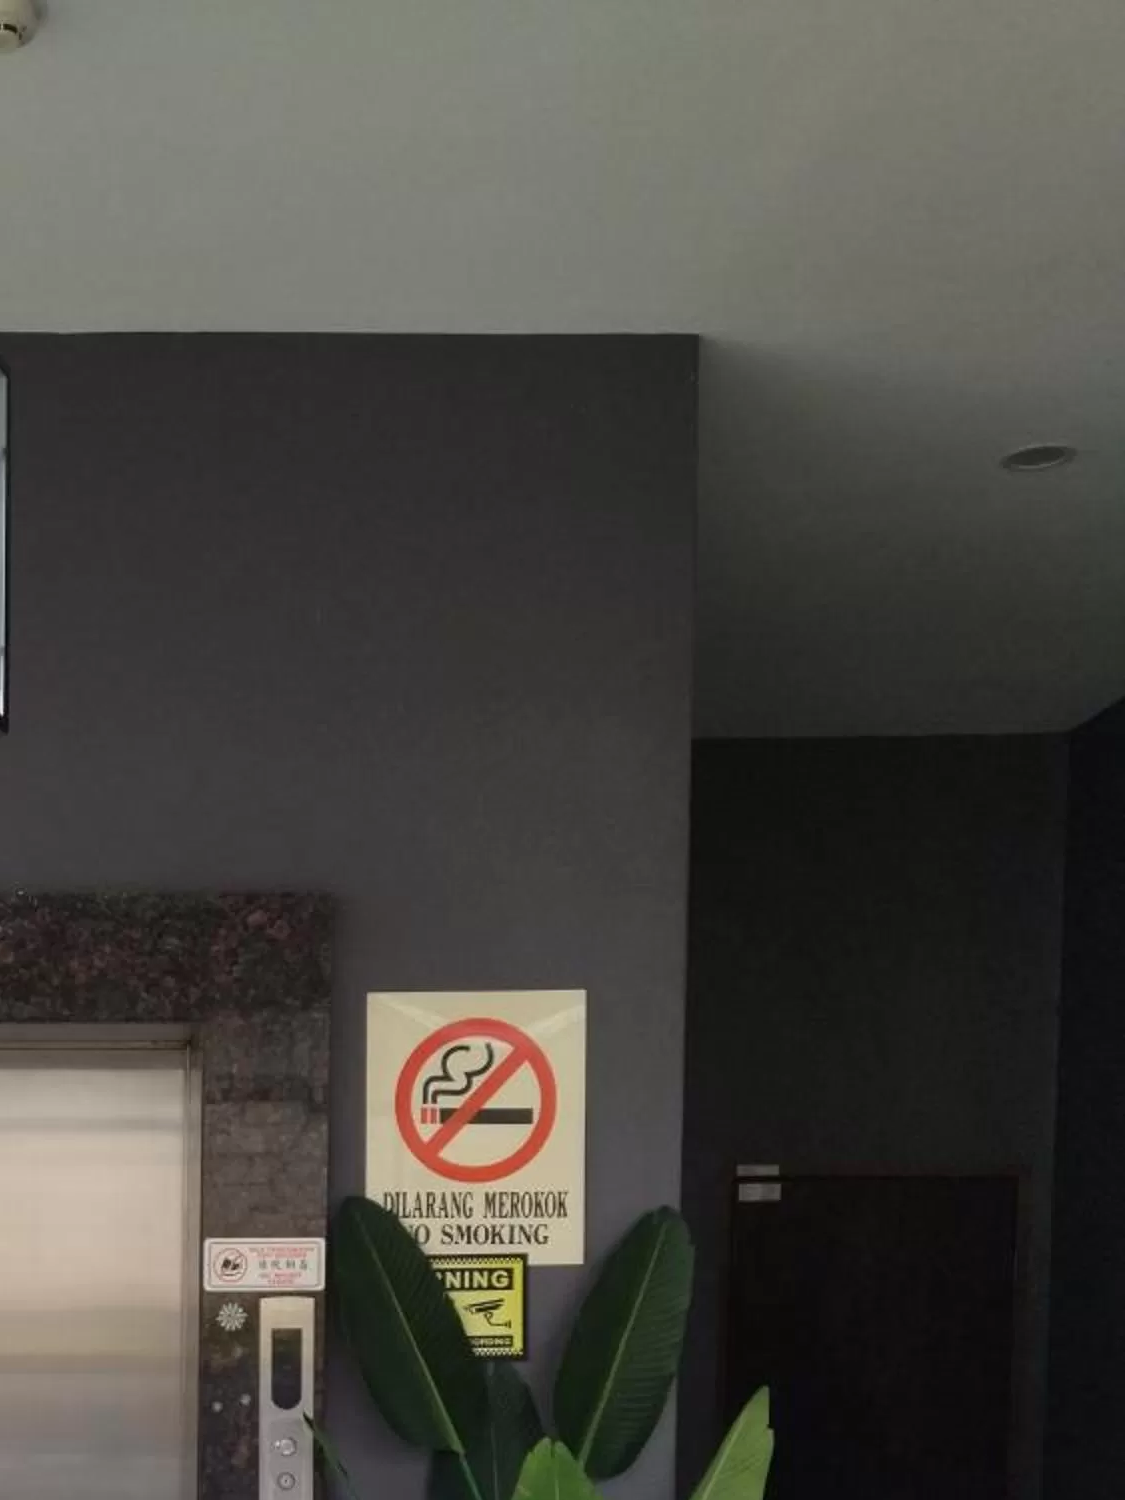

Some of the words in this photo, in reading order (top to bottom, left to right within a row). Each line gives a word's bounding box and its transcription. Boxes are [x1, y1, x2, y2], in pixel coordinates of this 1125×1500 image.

[383, 1191, 475, 1219] DILARANG
[483, 1191, 570, 1219] MEROKOK
[440, 1223, 550, 1245] SMOKING
[435, 1269, 510, 1289] NING
